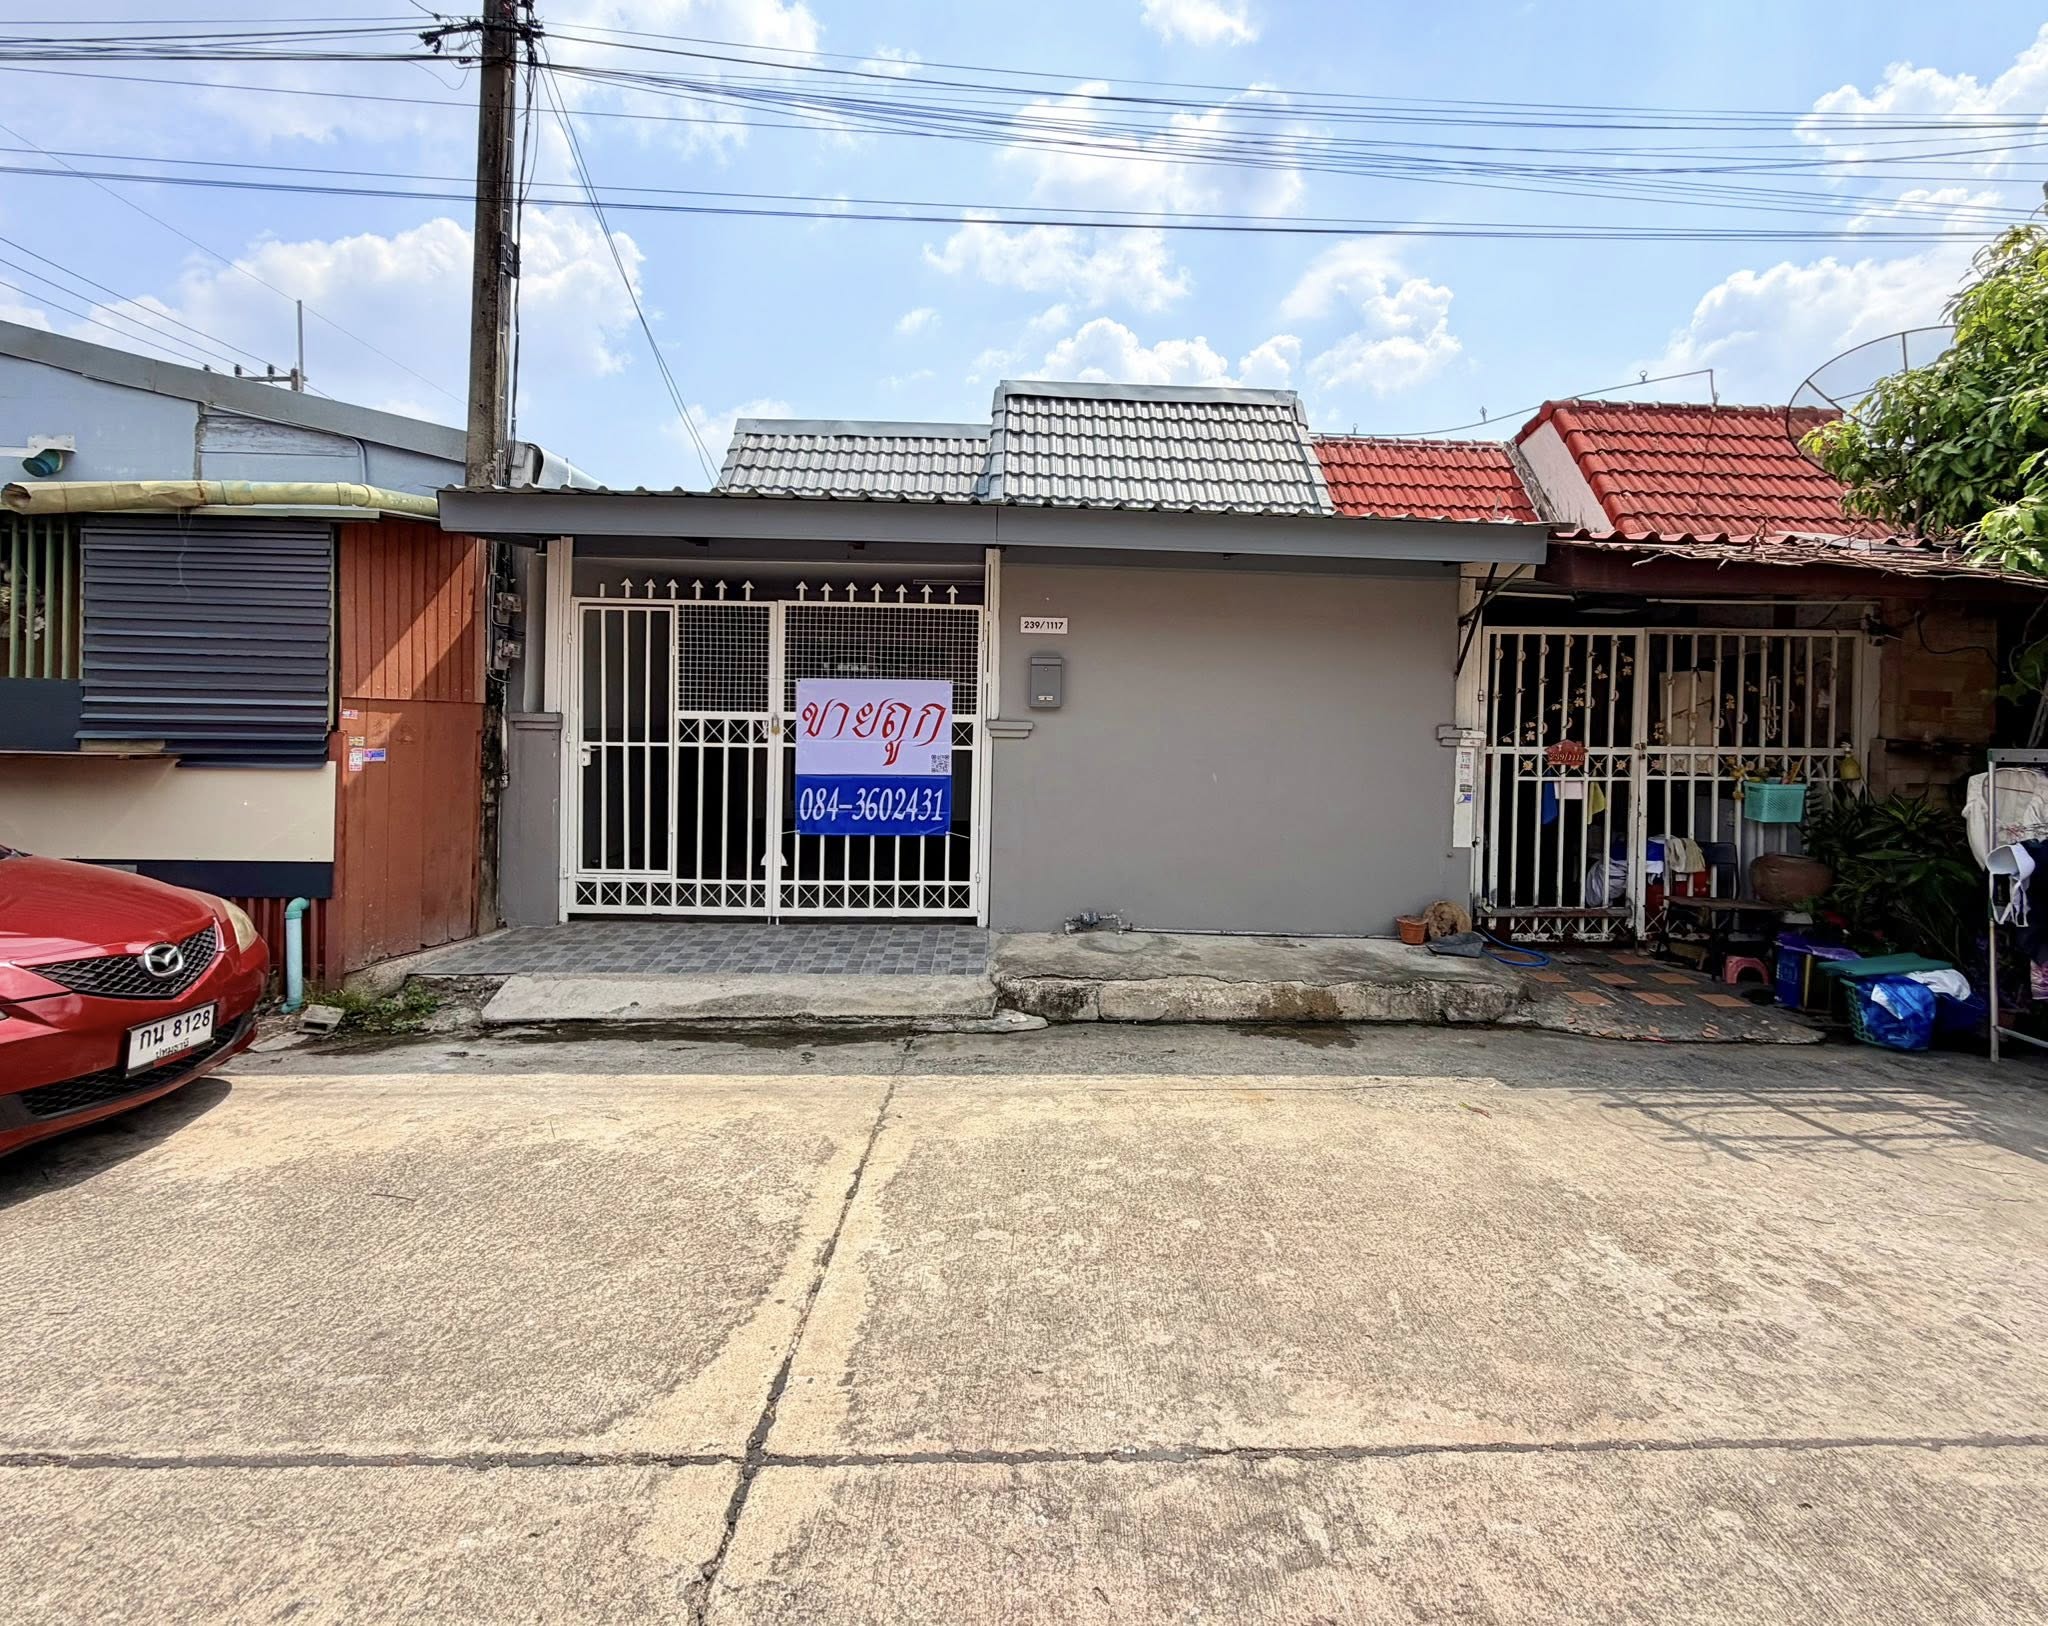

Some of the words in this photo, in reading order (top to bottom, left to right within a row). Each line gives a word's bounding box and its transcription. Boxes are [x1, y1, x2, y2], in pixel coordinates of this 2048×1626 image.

[1024, 621, 1064, 630] 239/1117
[802, 698, 946, 766] ขายถูก
[800, 787, 944, 821] 084-3602431
[139, 1025, 165, 1050] กน
[173, 1009, 210, 1037] 8128
